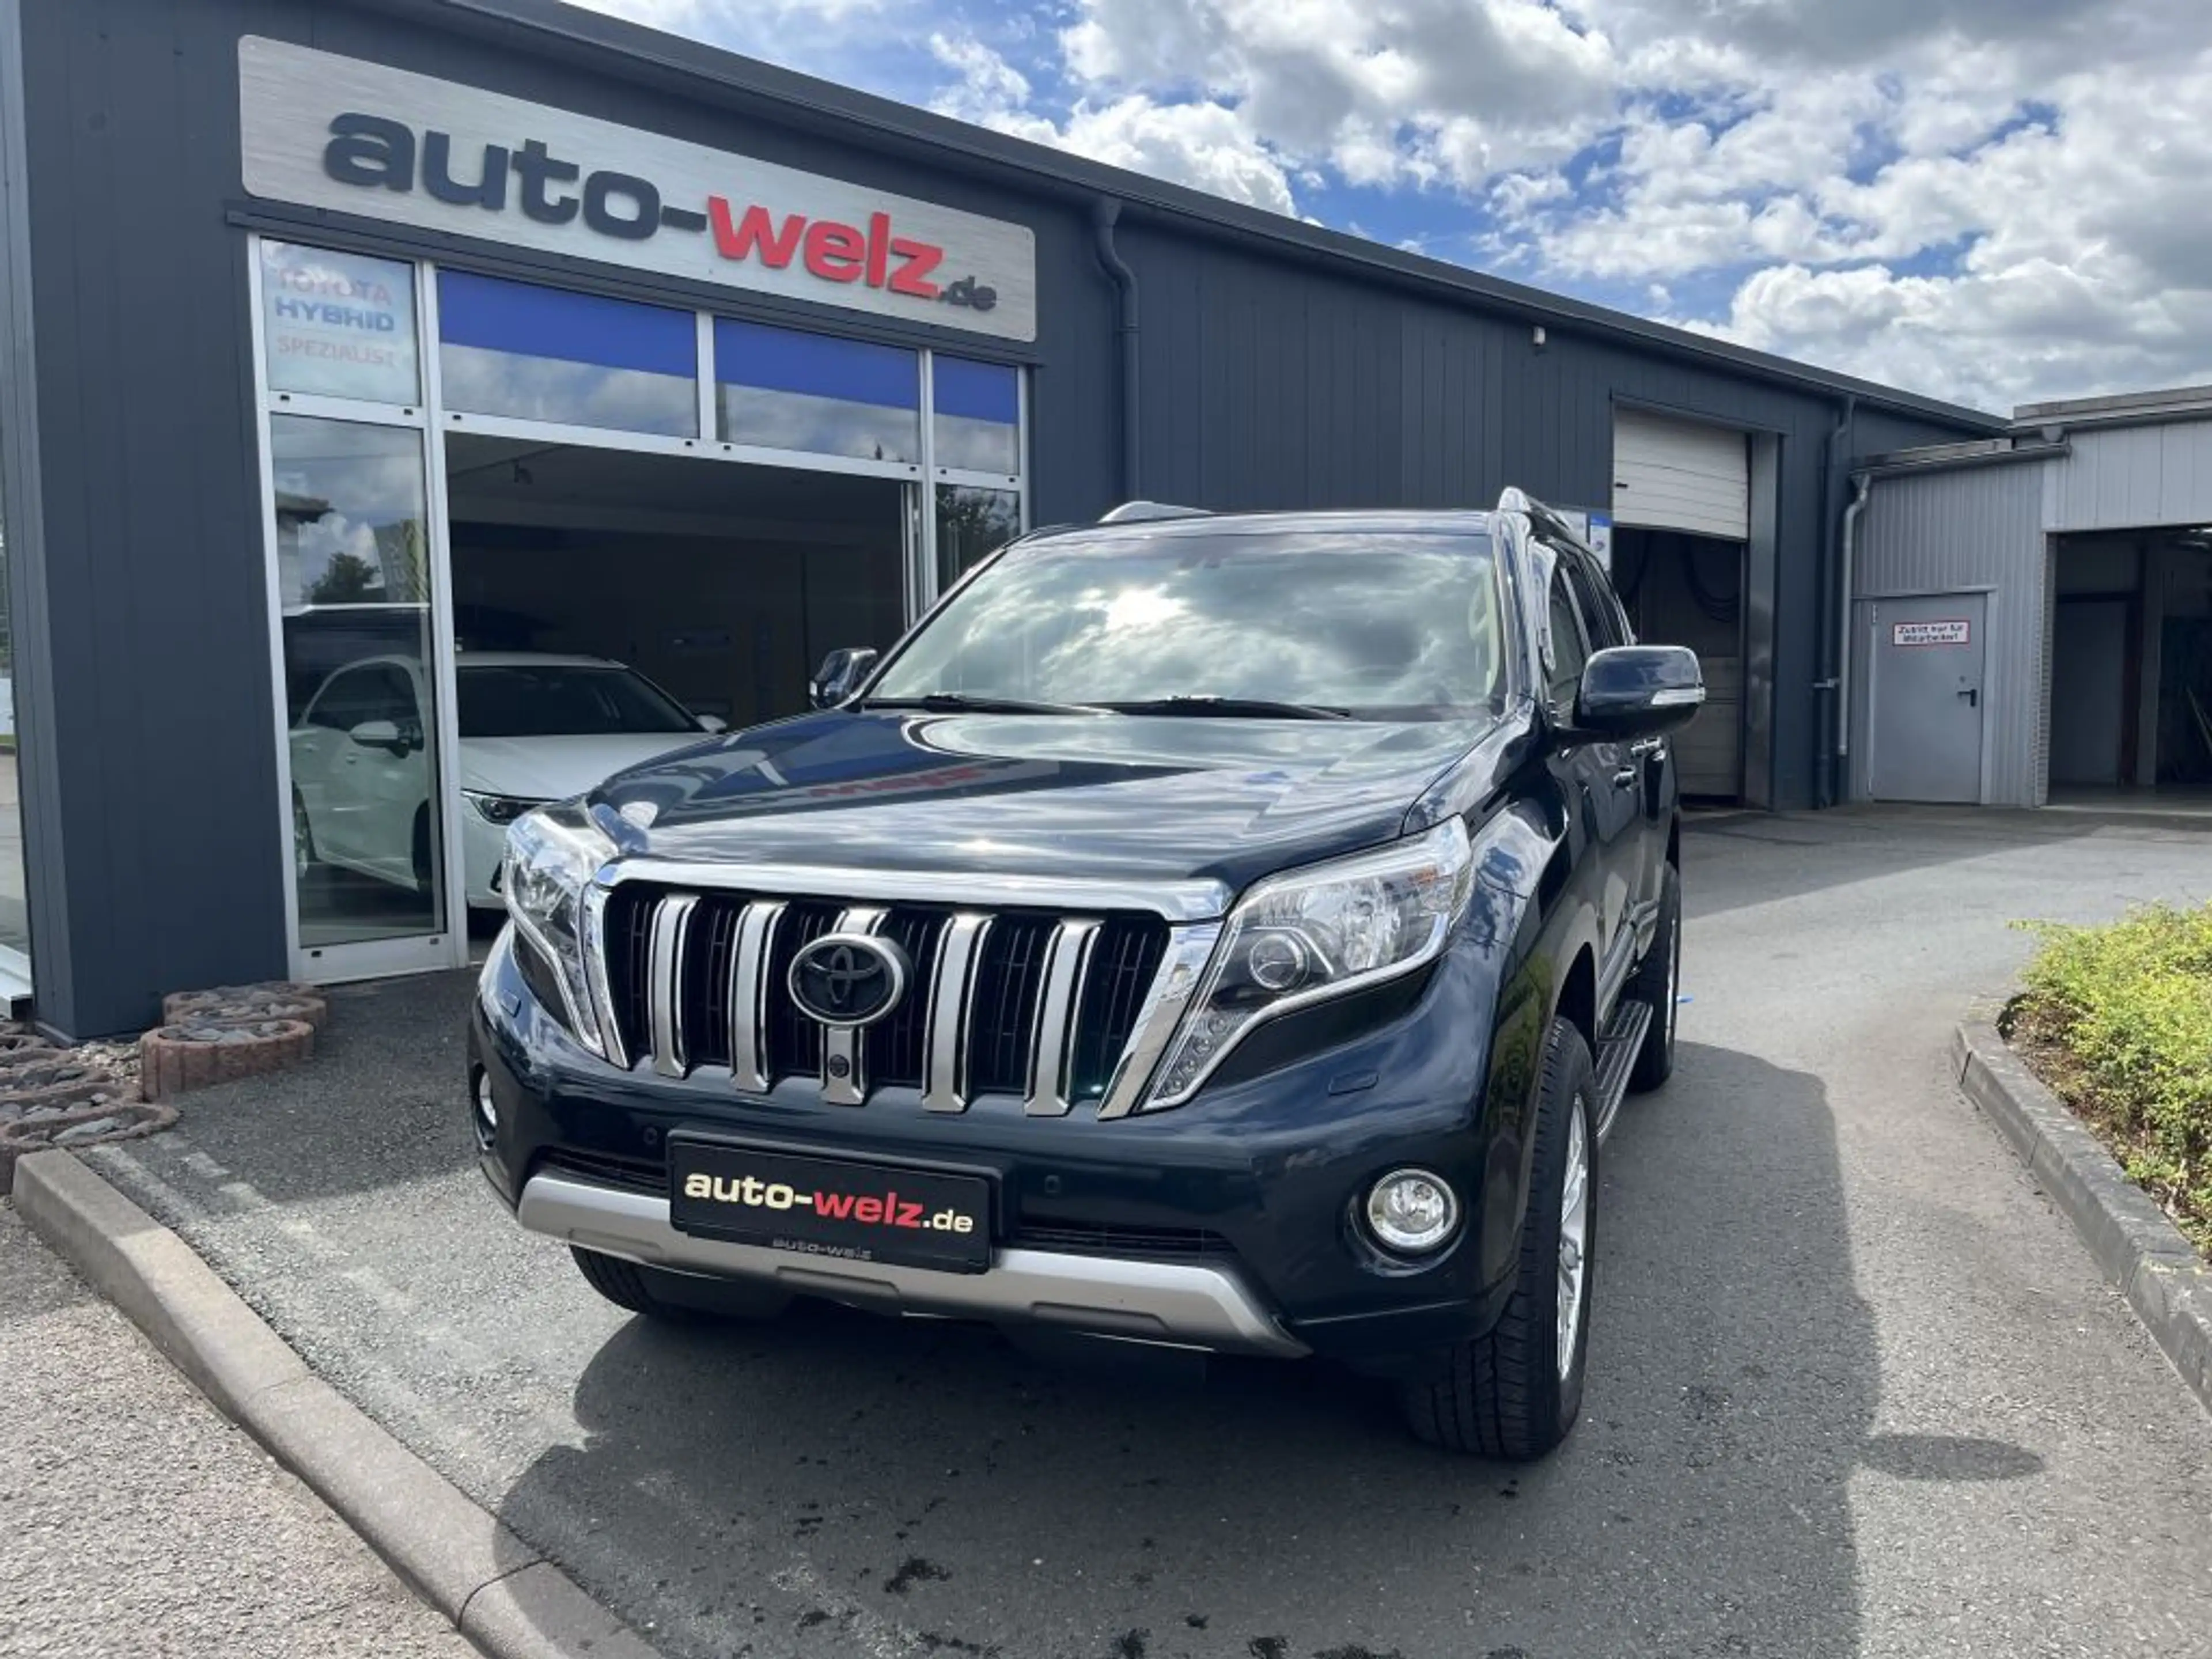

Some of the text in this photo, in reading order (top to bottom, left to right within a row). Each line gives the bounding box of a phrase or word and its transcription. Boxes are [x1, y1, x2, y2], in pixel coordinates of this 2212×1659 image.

[324, 112, 998, 312] auto-welz.de
[279, 268, 392, 306] TOYOTA
[274, 296, 395, 332] HYBRID
[276, 335, 396, 368] SPEZIALIST
[684, 1172, 974, 1233] auto-welz.de
